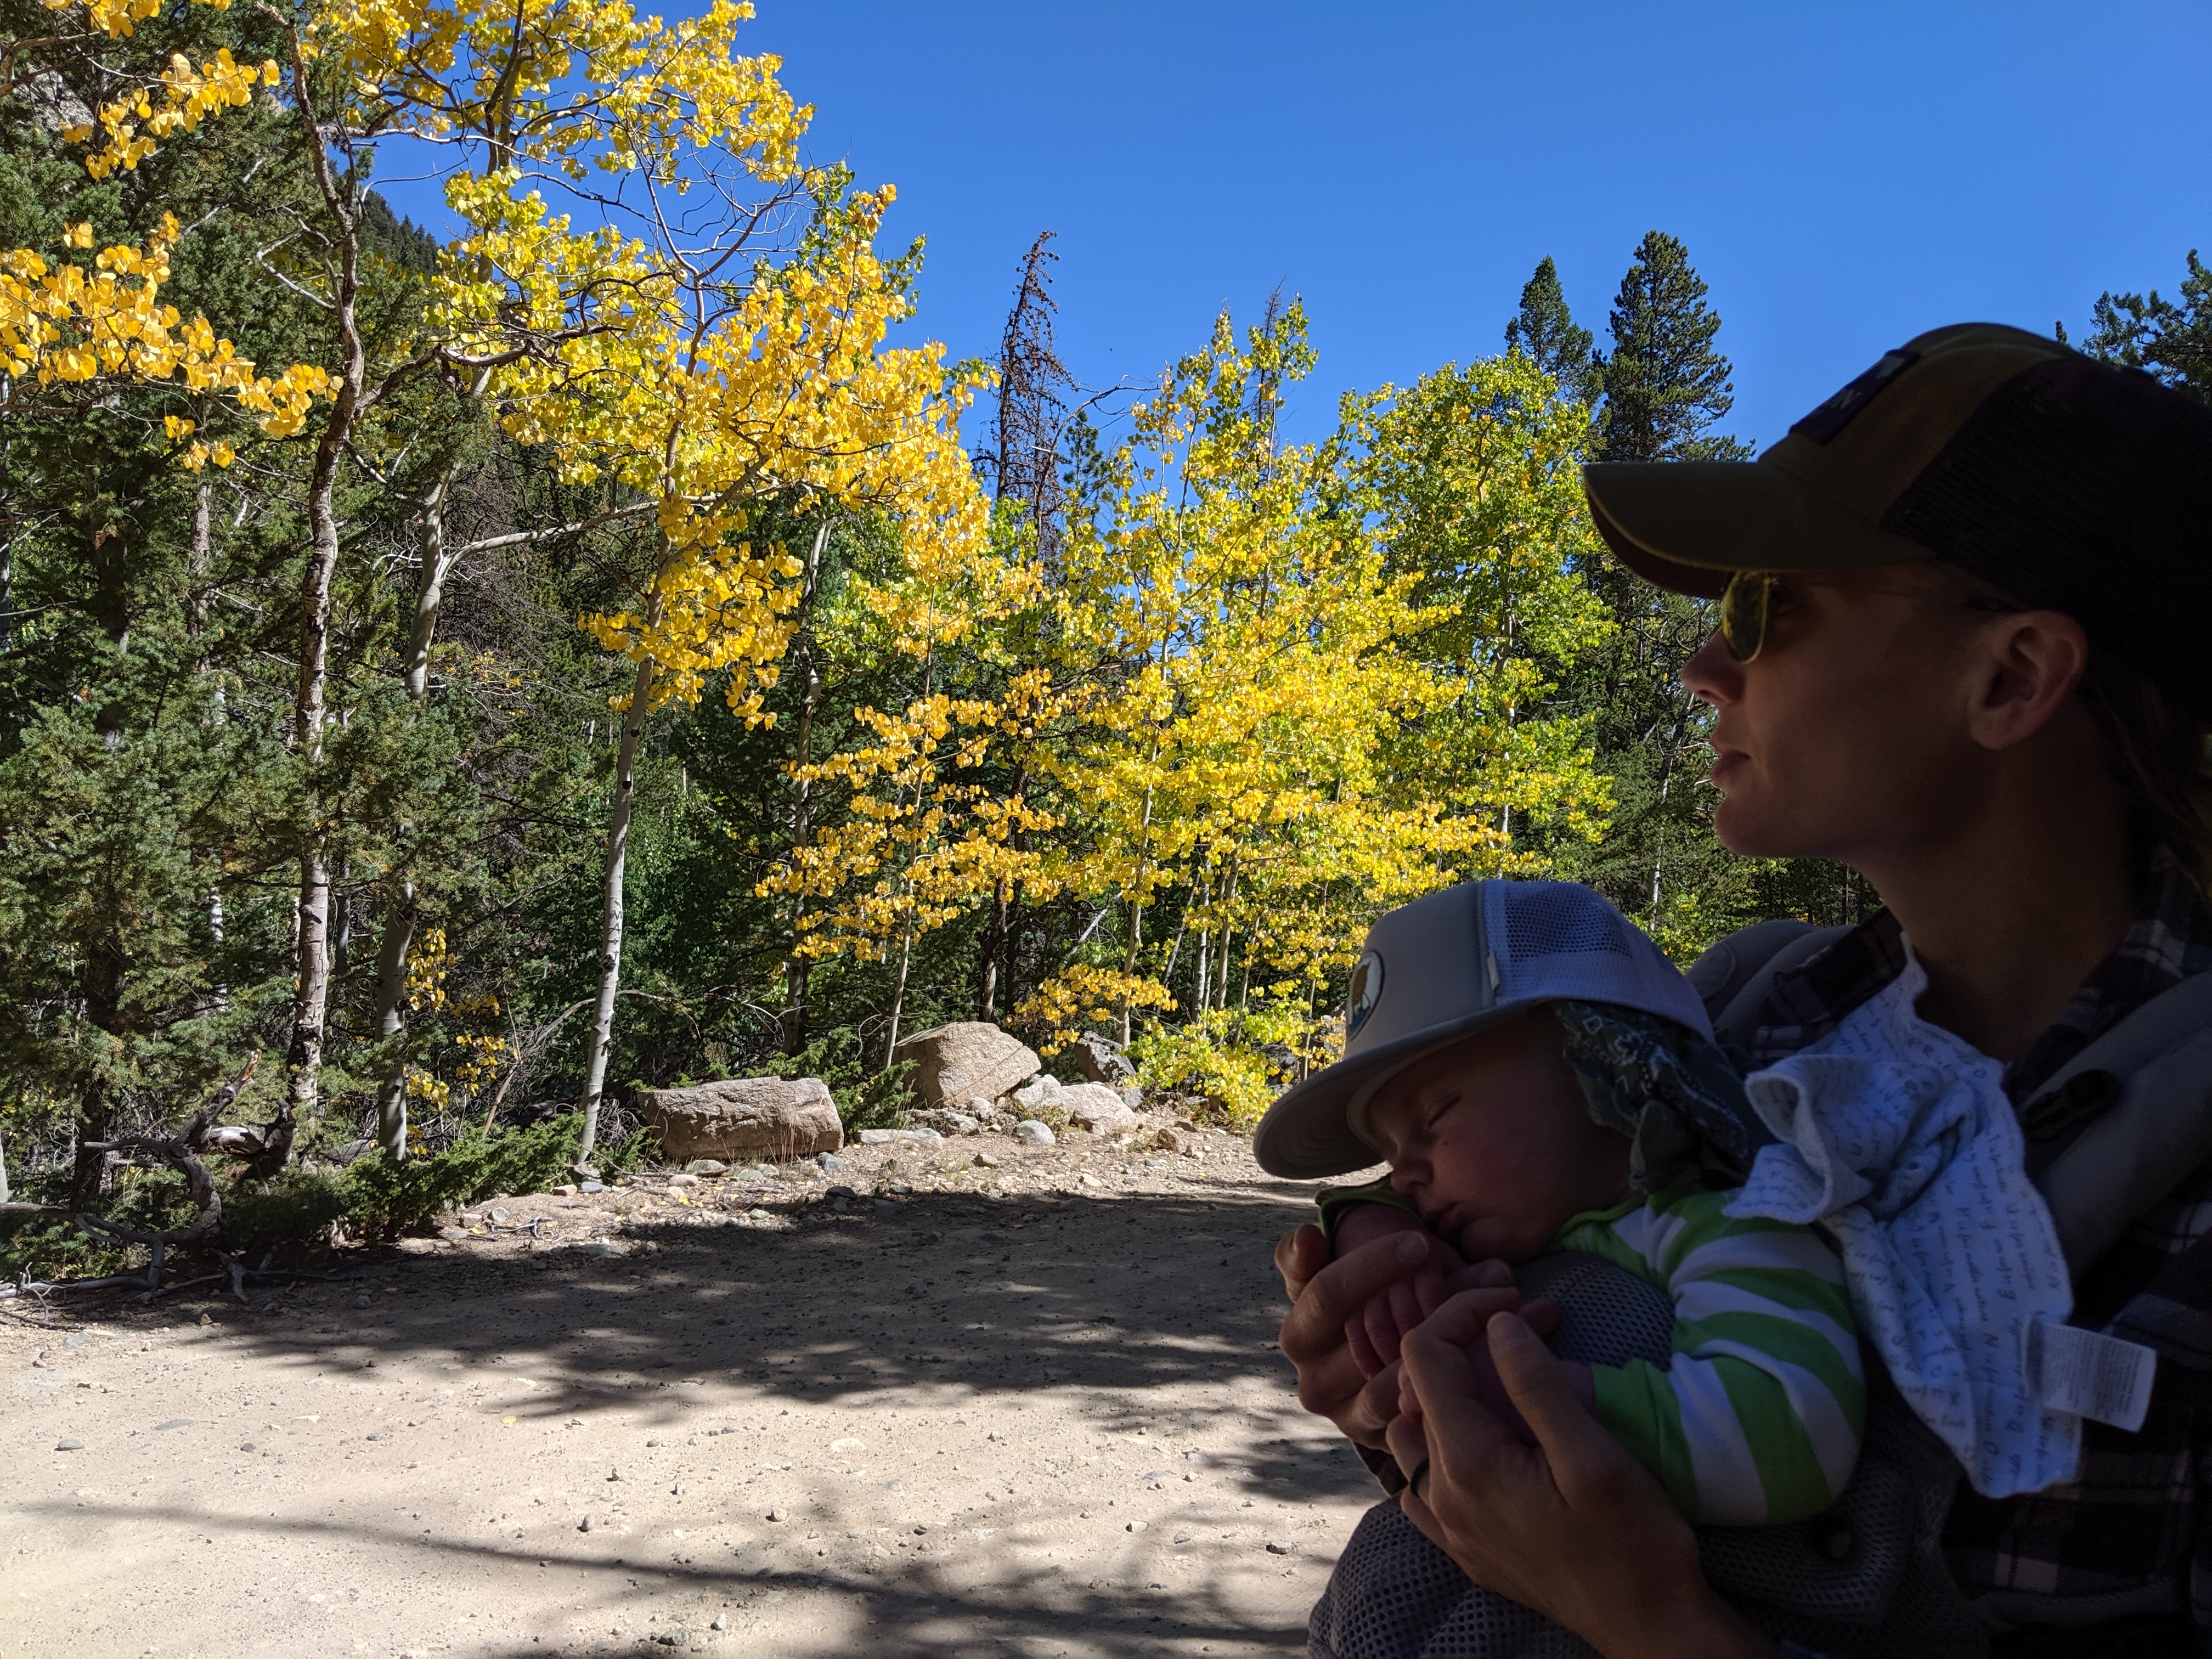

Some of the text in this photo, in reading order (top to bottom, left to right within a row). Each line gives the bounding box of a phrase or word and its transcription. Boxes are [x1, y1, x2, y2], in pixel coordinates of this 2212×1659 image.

[1996, 1288, 2015, 1300] E
[1982, 1334, 2000, 1346] N
[2006, 1420, 2023, 1432] D
